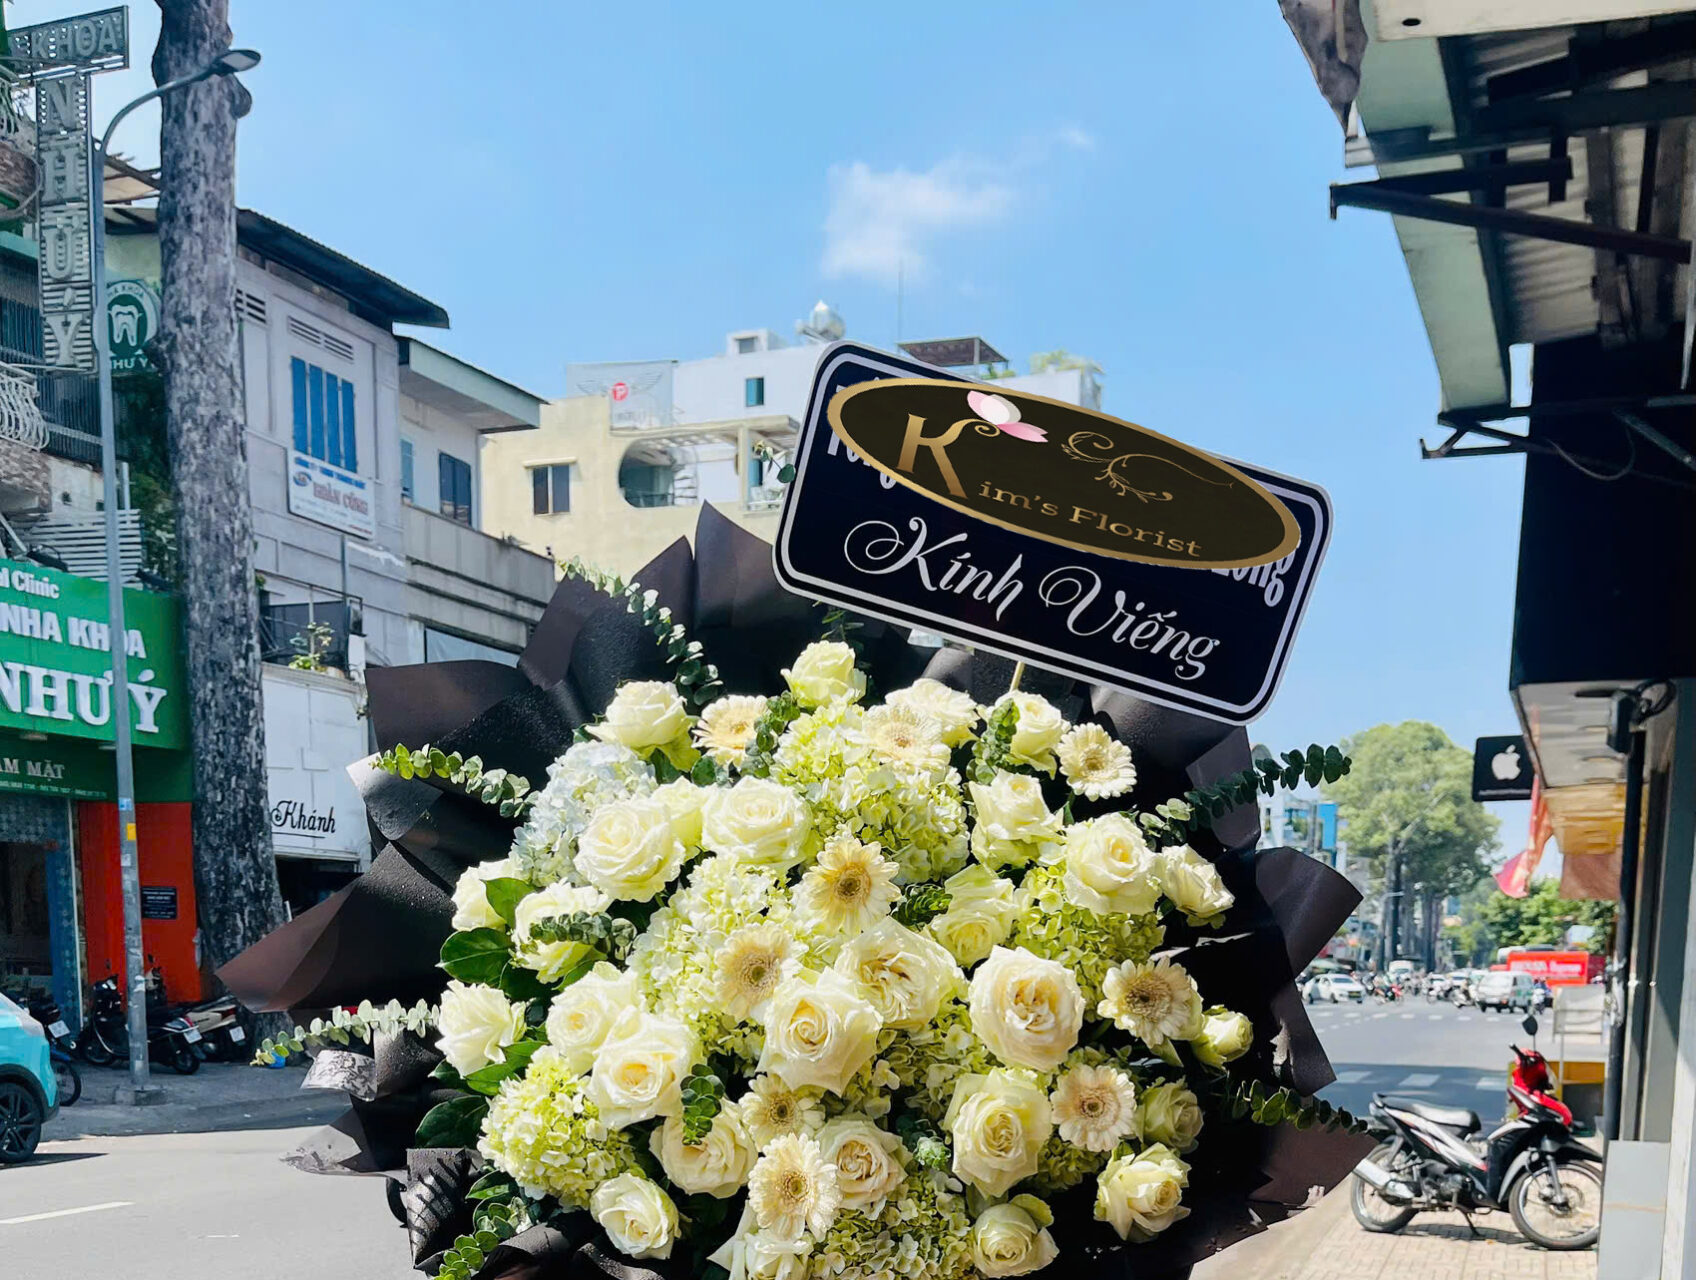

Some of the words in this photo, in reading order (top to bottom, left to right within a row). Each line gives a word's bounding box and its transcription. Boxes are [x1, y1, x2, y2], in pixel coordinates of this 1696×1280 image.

[31, 15, 118, 60] KHOA
[11, 570, 60, 599] Clinic
[844, 516, 1024, 622] Kính
[1038, 565, 1221, 681] Viếng
[0, 602, 62, 644] NHA
[127, 669, 168, 733] Ý
[26, 760, 65, 782] MẶT
[271, 800, 336, 833] Khánh
